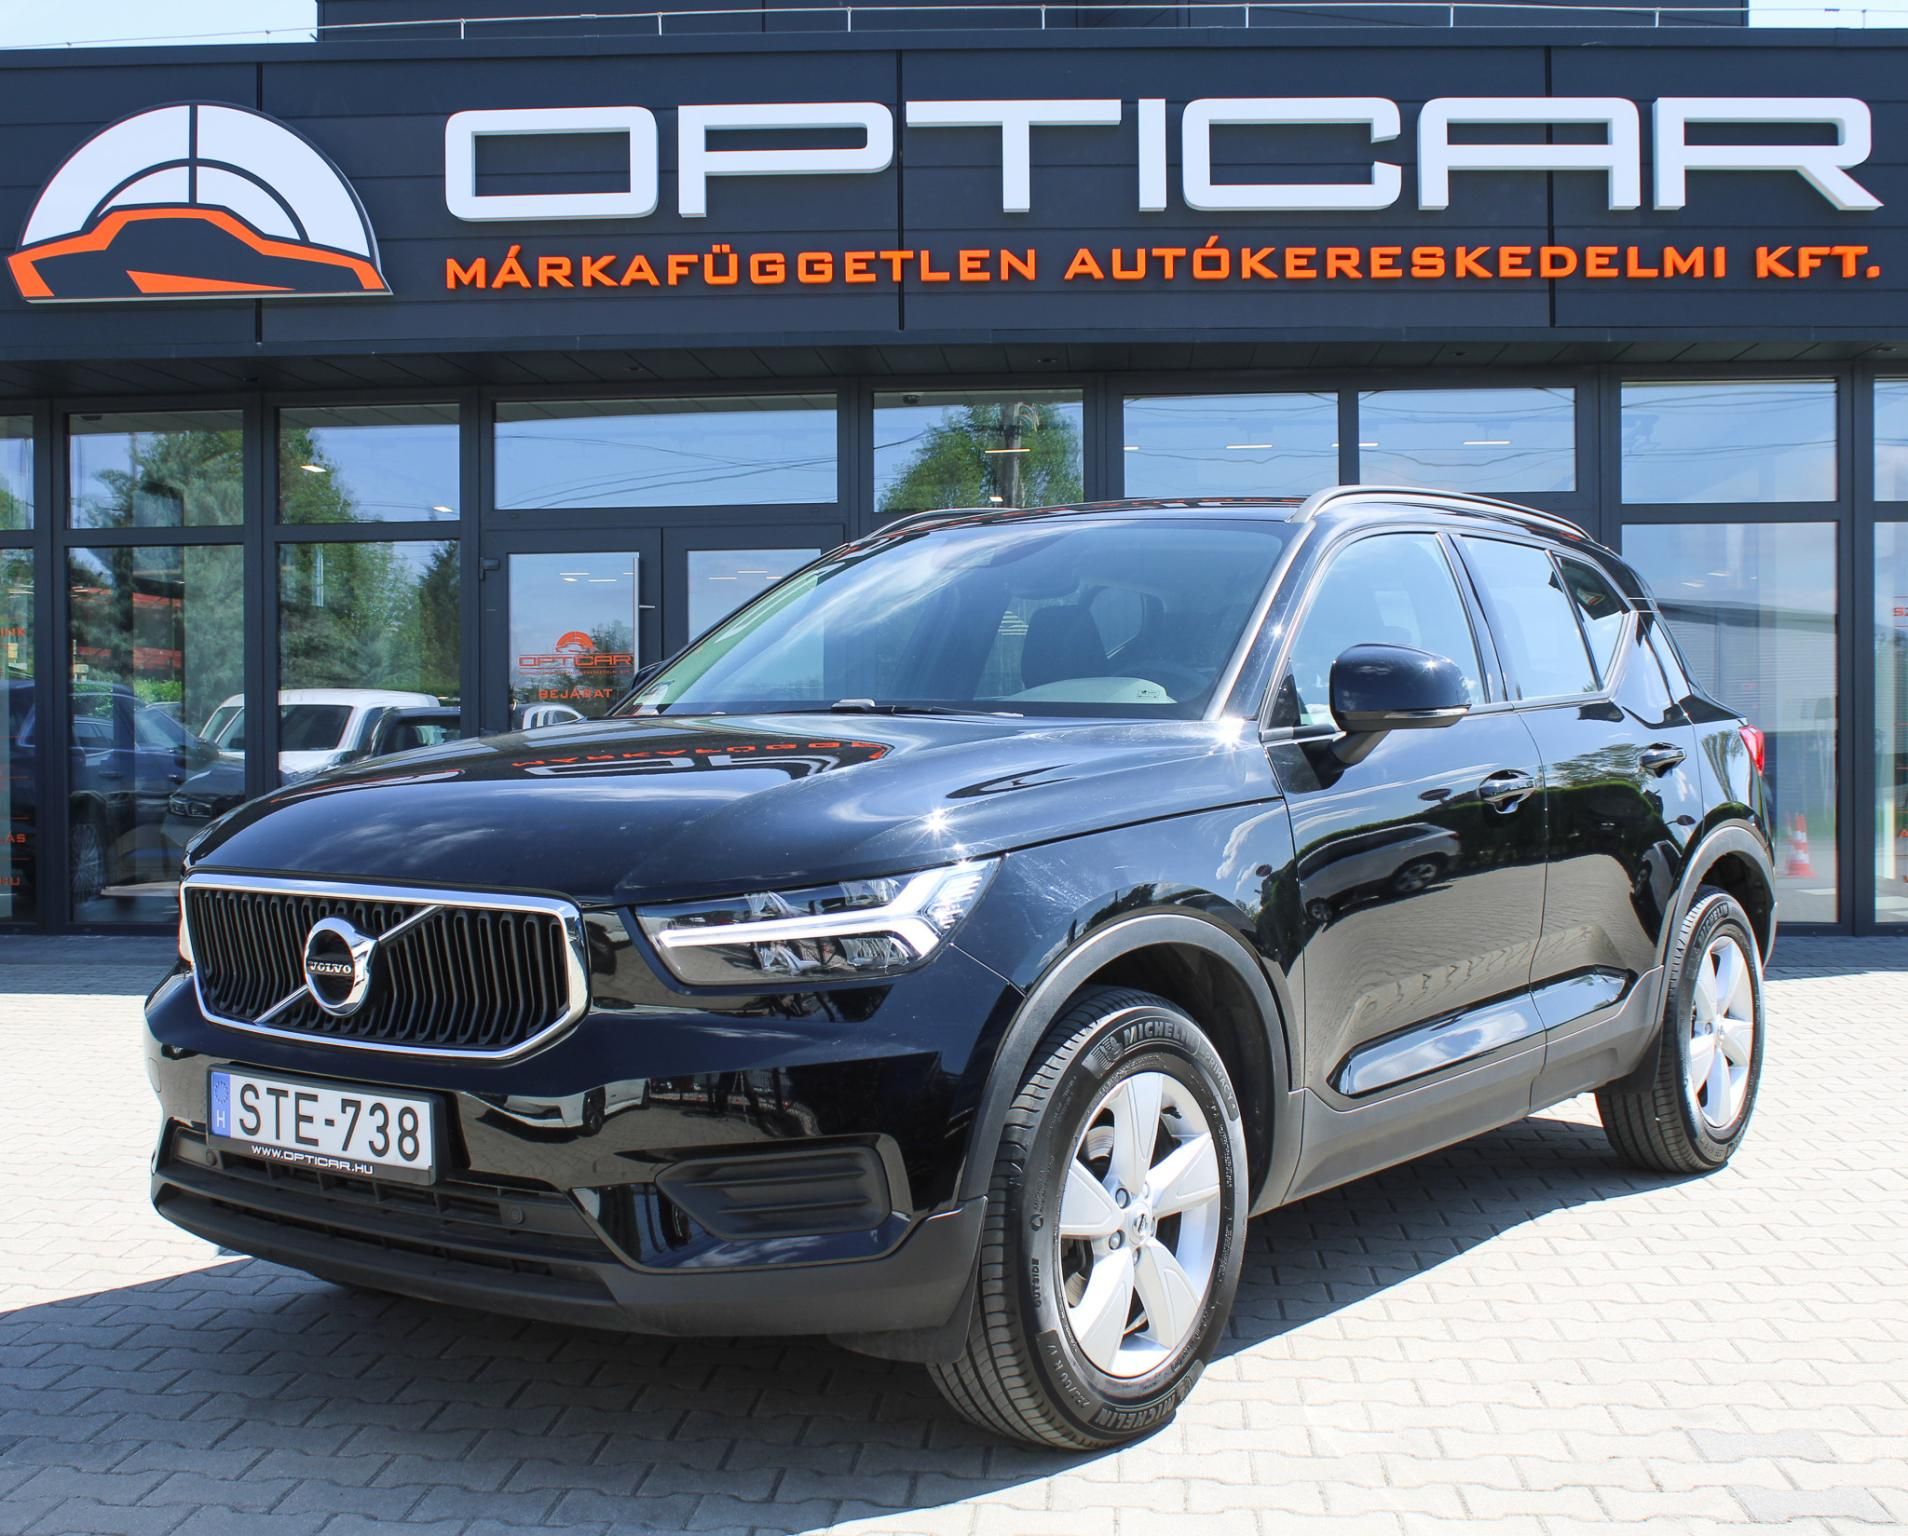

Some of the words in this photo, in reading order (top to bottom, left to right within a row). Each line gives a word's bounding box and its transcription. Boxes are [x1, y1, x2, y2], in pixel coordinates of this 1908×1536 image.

[445, 96, 1885, 221] OPTICAR
[445, 243, 1037, 290] MÁRKAFÜGGETLEN
[1064, 234, 1728, 282] AUTÓKERESKEDELMI
[1755, 244, 1882, 280] KFT.
[308, 961, 352, 974] VOLVO
[1123, 1021, 1200, 1050] MICHELIN
[216, 1109, 227, 1129] H
[239, 1083, 421, 1162] STE-738
[251, 1144, 374, 1175] WWW.OPTICAR.HU
